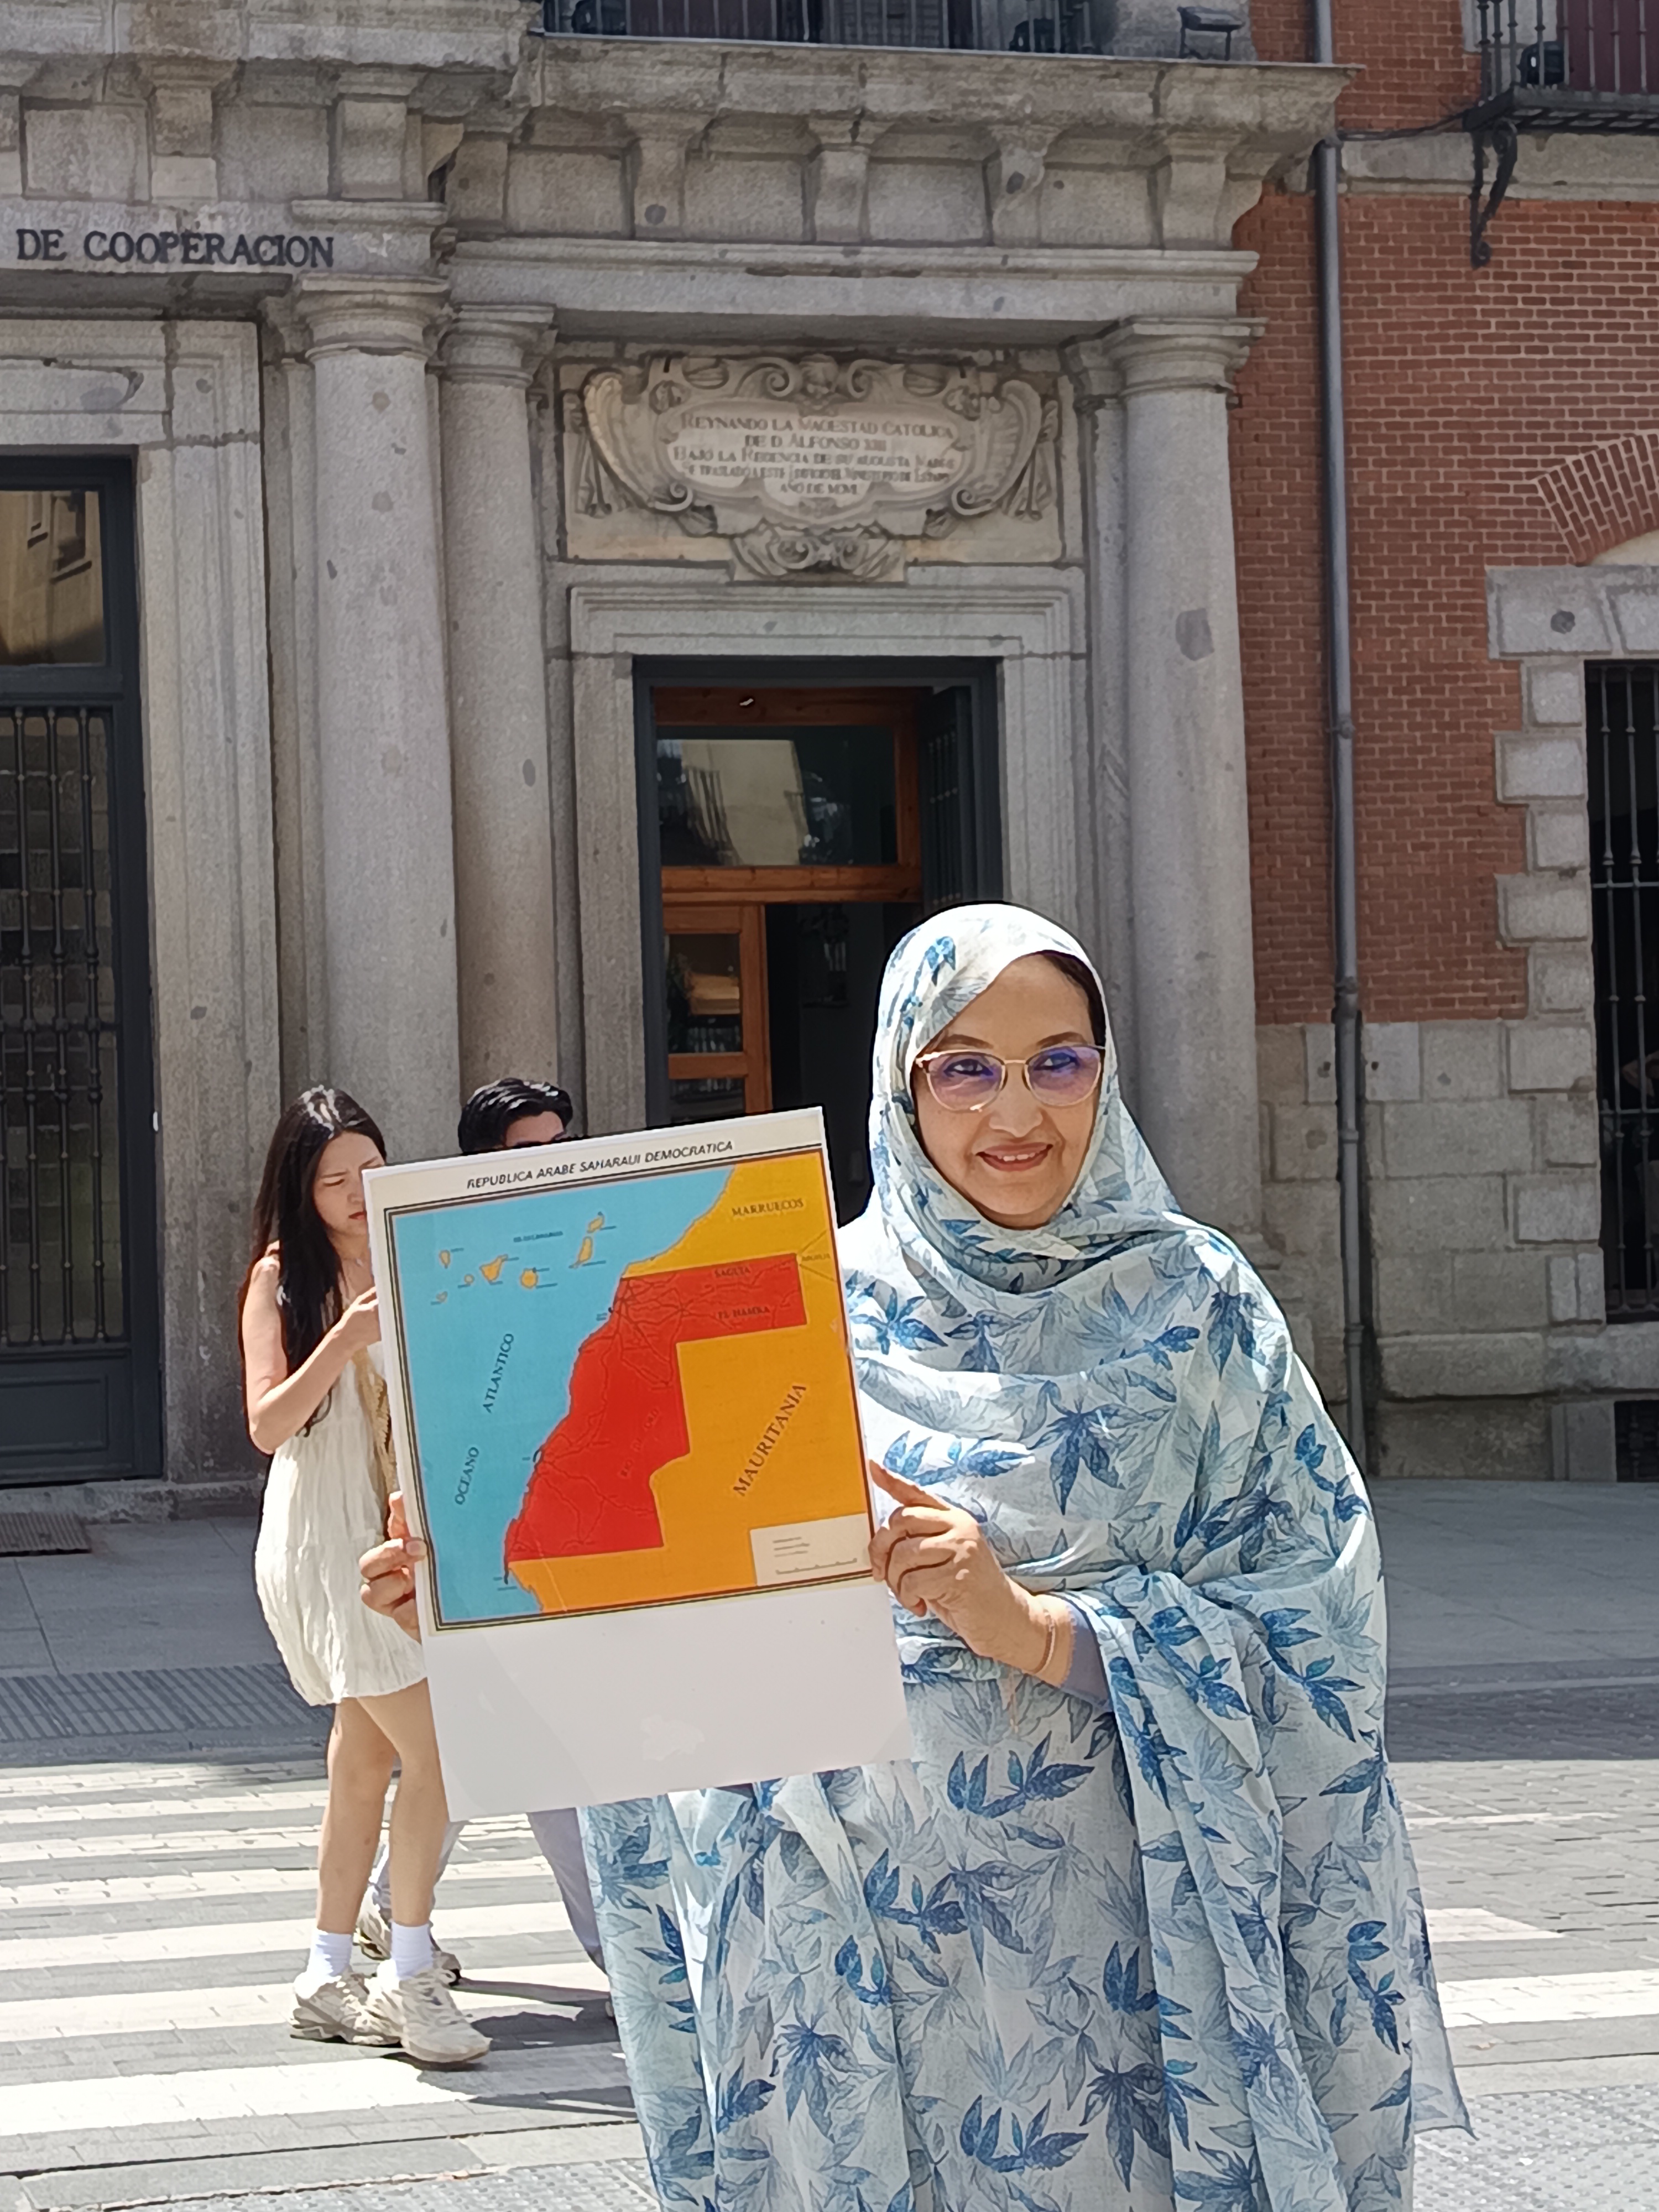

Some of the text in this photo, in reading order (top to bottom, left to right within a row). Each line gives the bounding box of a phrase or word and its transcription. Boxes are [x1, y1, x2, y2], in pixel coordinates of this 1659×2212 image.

[16, 228, 335, 268] DE COOPERACION
[771, 419, 793, 431] LA
[718, 450, 737, 462] LA
[744, 435, 766, 447] DE
[787, 433, 860, 450] ALFONSO
[467, 1170, 533, 1190] REPUBLICA
[536, 1163, 577, 1179] ARABE
[645, 1140, 733, 1163] DEMOCRATICA
[731, 1198, 805, 1217] MARRUECOS
[482, 1333, 515, 1413] ATLANTICO
[732, 1385, 807, 1497] MAURITANIA
